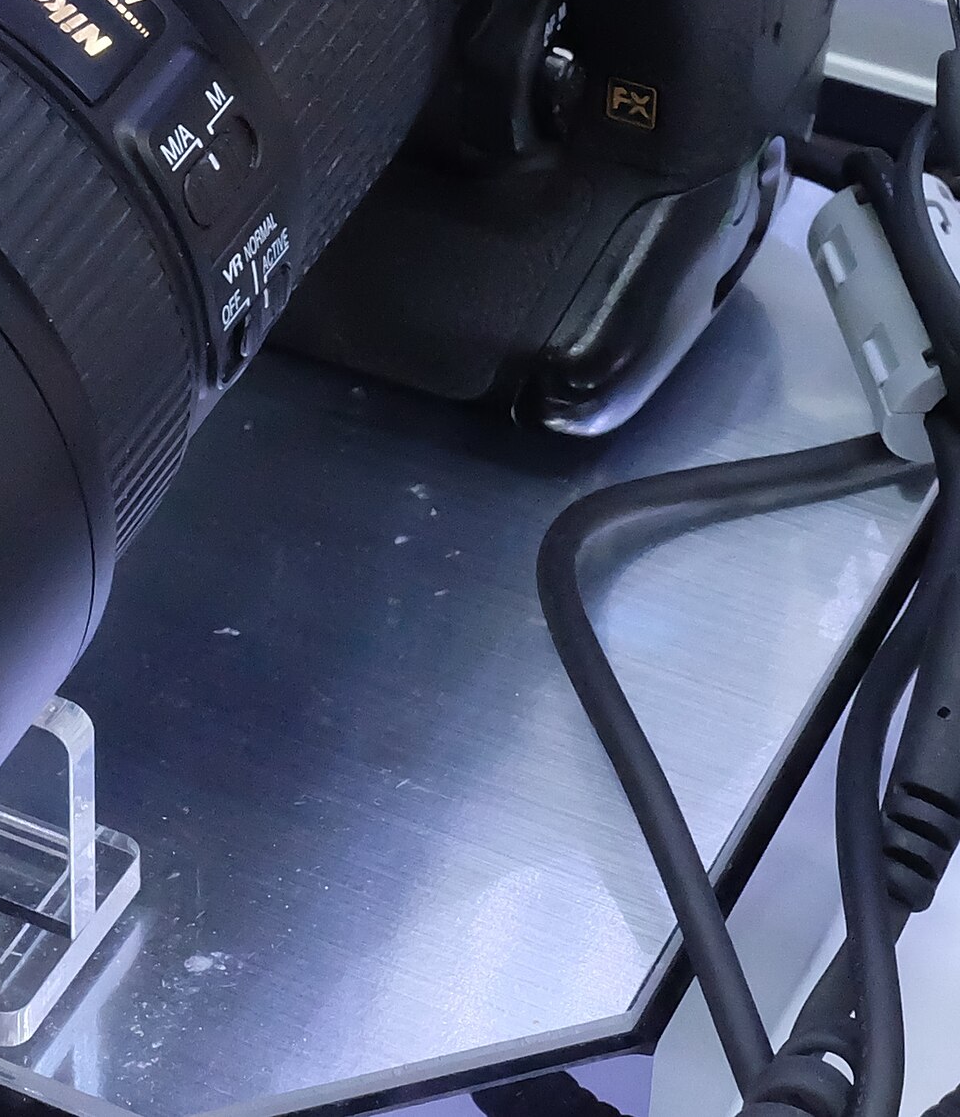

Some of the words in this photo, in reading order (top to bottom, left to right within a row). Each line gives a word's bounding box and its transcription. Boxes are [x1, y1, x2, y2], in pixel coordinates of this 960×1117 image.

[205, 81, 227, 110] M
[612, 86, 651, 119] FX
[159, 124, 195, 166] M/A
[222, 253, 244, 284] VR
[243, 212, 277, 262] NORMAL
[221, 289, 241, 325] OFF
[262, 227, 290, 273] ACTIVE
